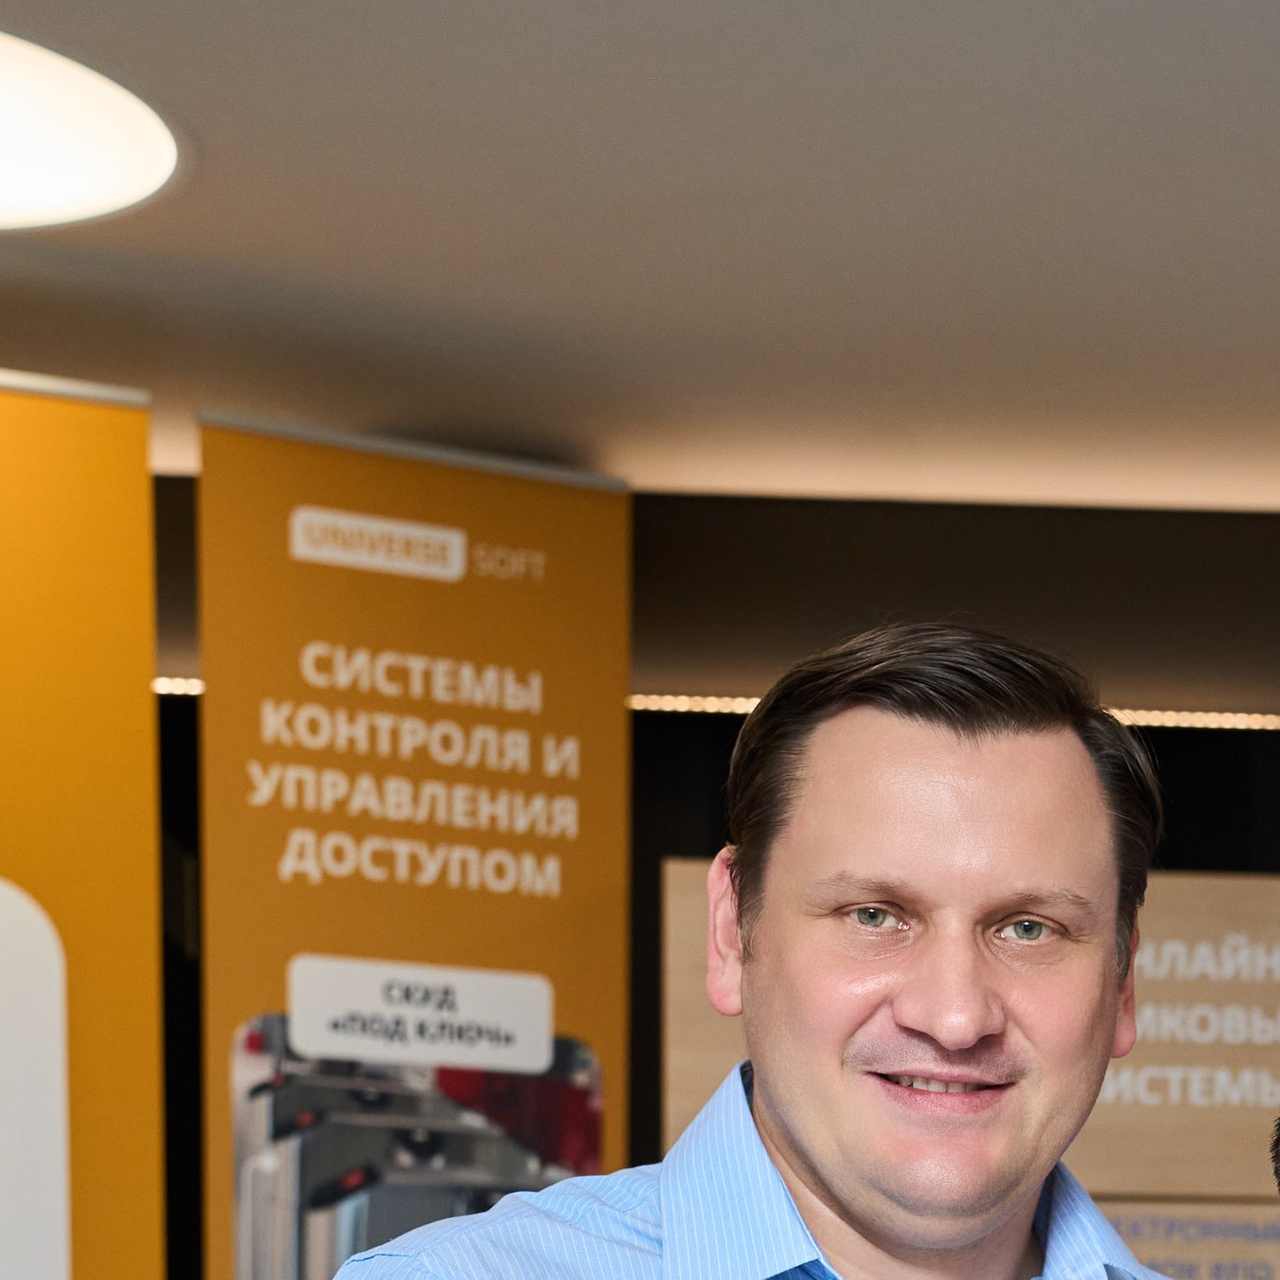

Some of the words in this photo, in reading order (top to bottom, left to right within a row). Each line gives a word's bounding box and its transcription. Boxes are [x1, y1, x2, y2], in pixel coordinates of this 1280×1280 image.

[300, 640, 543, 713] СИСТЕМЫ
[260, 698, 531, 774] КОНТРОЛЯ
[543, 735, 581, 781] И
[245, 759, 578, 840] УПРАВЛЕНИЯ
[278, 828, 561, 898] ДОСТУПОМ
